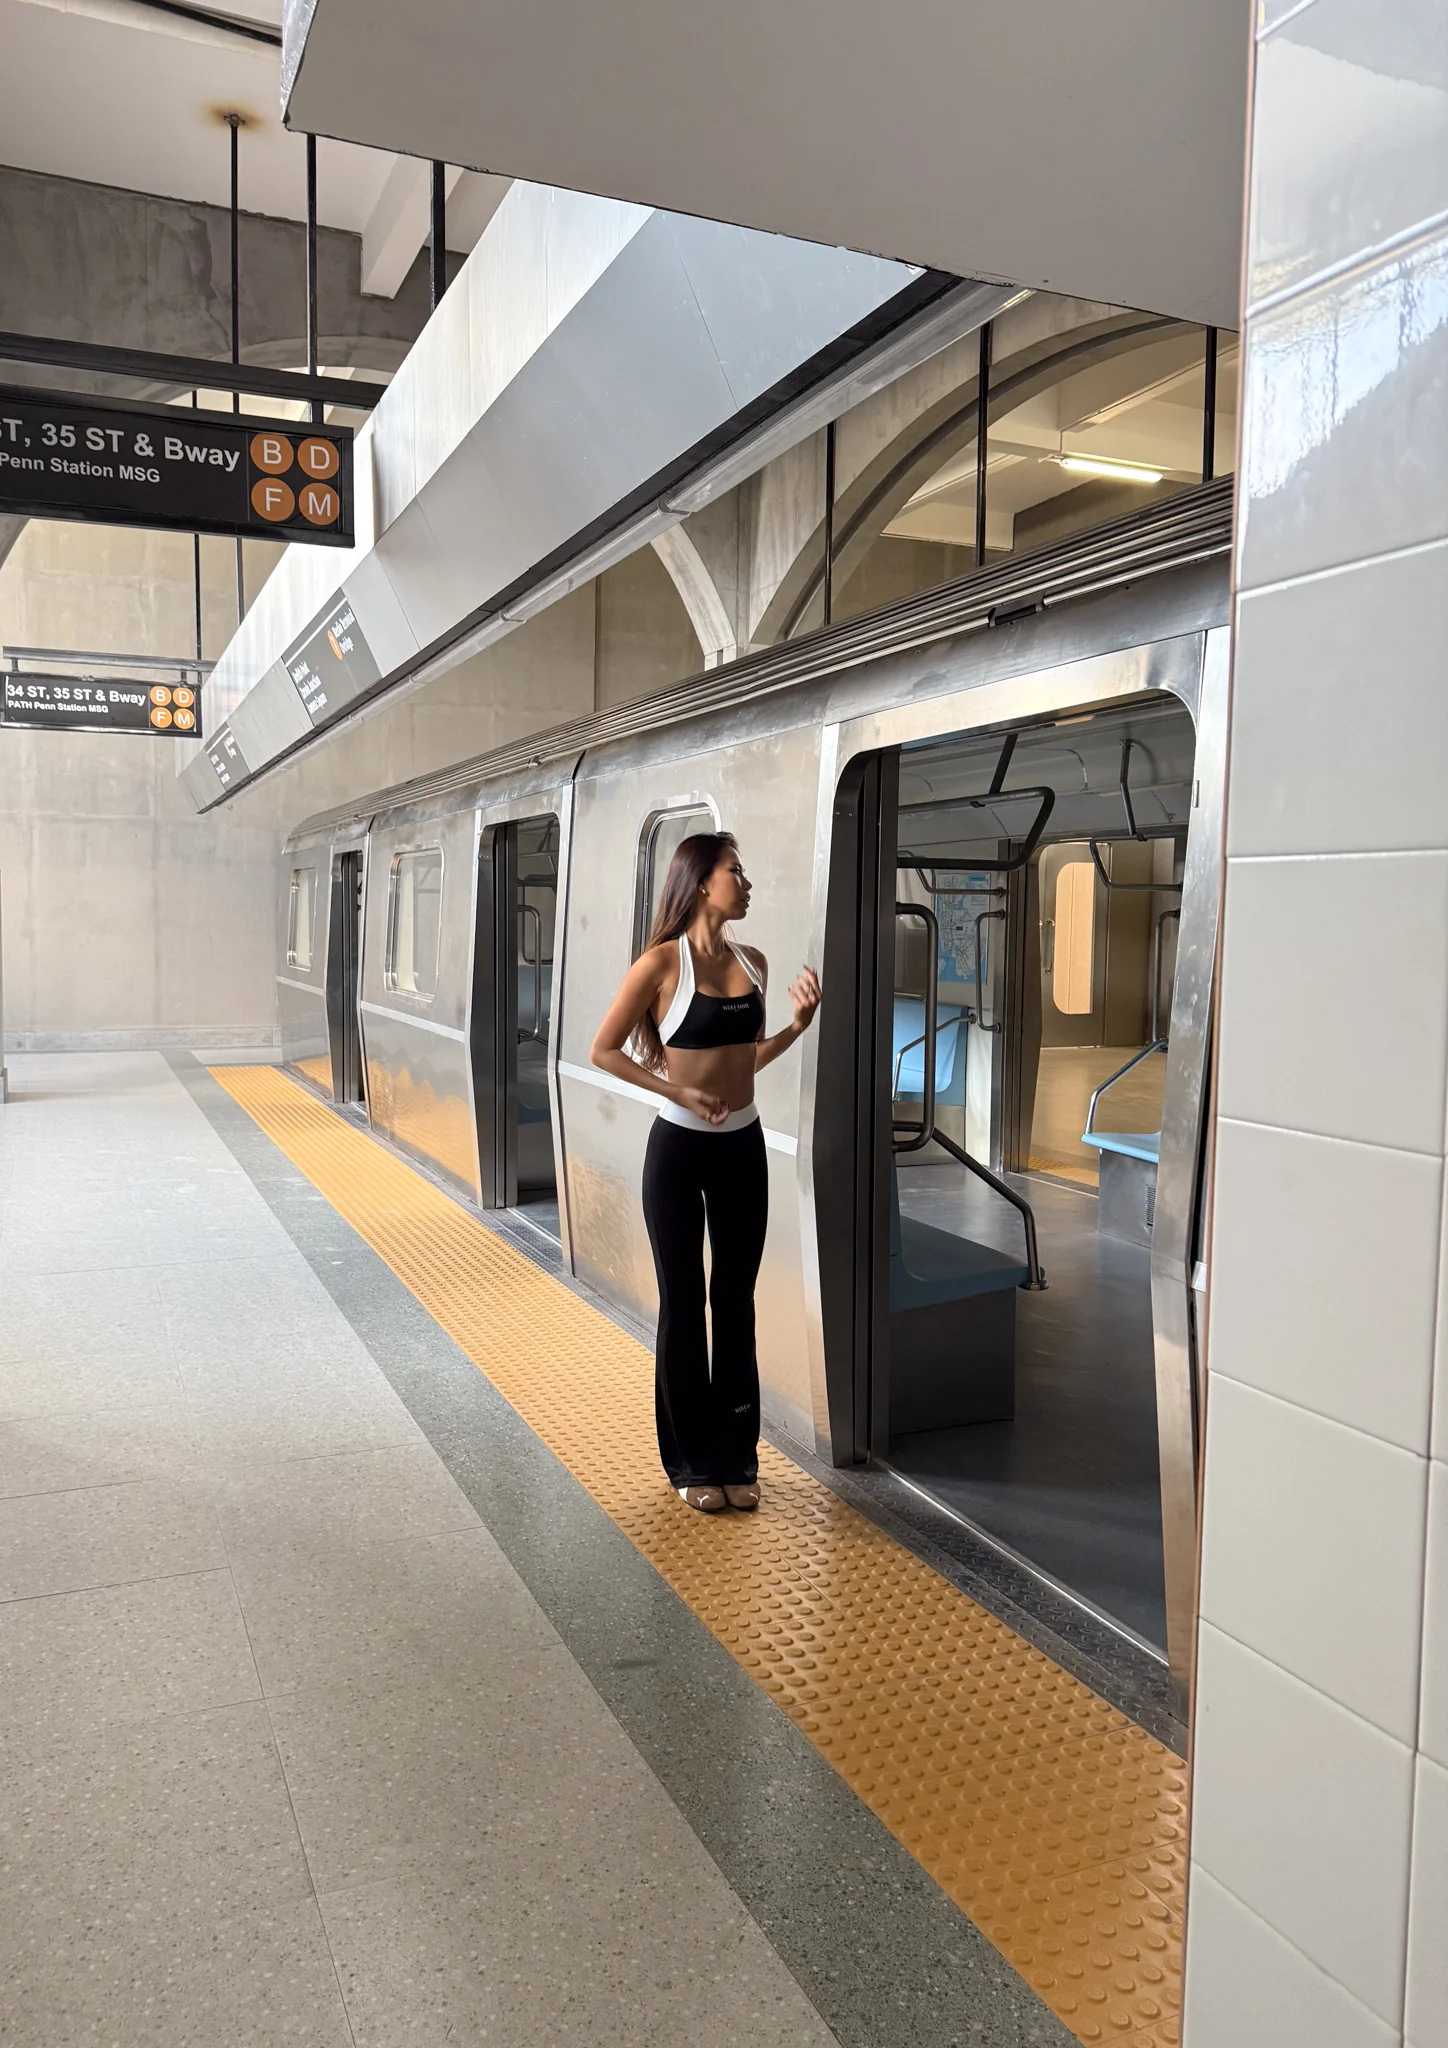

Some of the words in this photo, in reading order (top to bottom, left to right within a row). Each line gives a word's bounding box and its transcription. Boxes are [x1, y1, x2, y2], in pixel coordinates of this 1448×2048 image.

[0, 418, 31, 447] T,
[41, 423, 76, 447] 35
[85, 427, 124, 453] ST
[133, 433, 155, 457] &
[164, 436, 240, 472] Bway
[263, 439, 282, 464] B
[310, 445, 330, 469] D
[0, 452, 45, 471] Penn
[50, 457, 113, 478] Station
[119, 464, 160, 483] MSG
[265, 487, 282, 511] F
[308, 491, 331, 517] M
[7, 685, 24, 697] 34
[27, 686, 50, 700] ST,
[53, 688, 70, 699] 35
[73, 689, 92, 701] ST
[95, 690, 106, 702] &
[109, 691, 146, 706] Bway
[8, 700, 32, 709] PATH
[34, 702, 56, 711] Penn
[58, 703, 87, 713] Station
[88, 704, 109, 713] MSG
[155, 690, 166, 702] B
[178, 691, 190, 703] D
[157, 711, 166, 724] F
[178, 712, 191, 725] M
